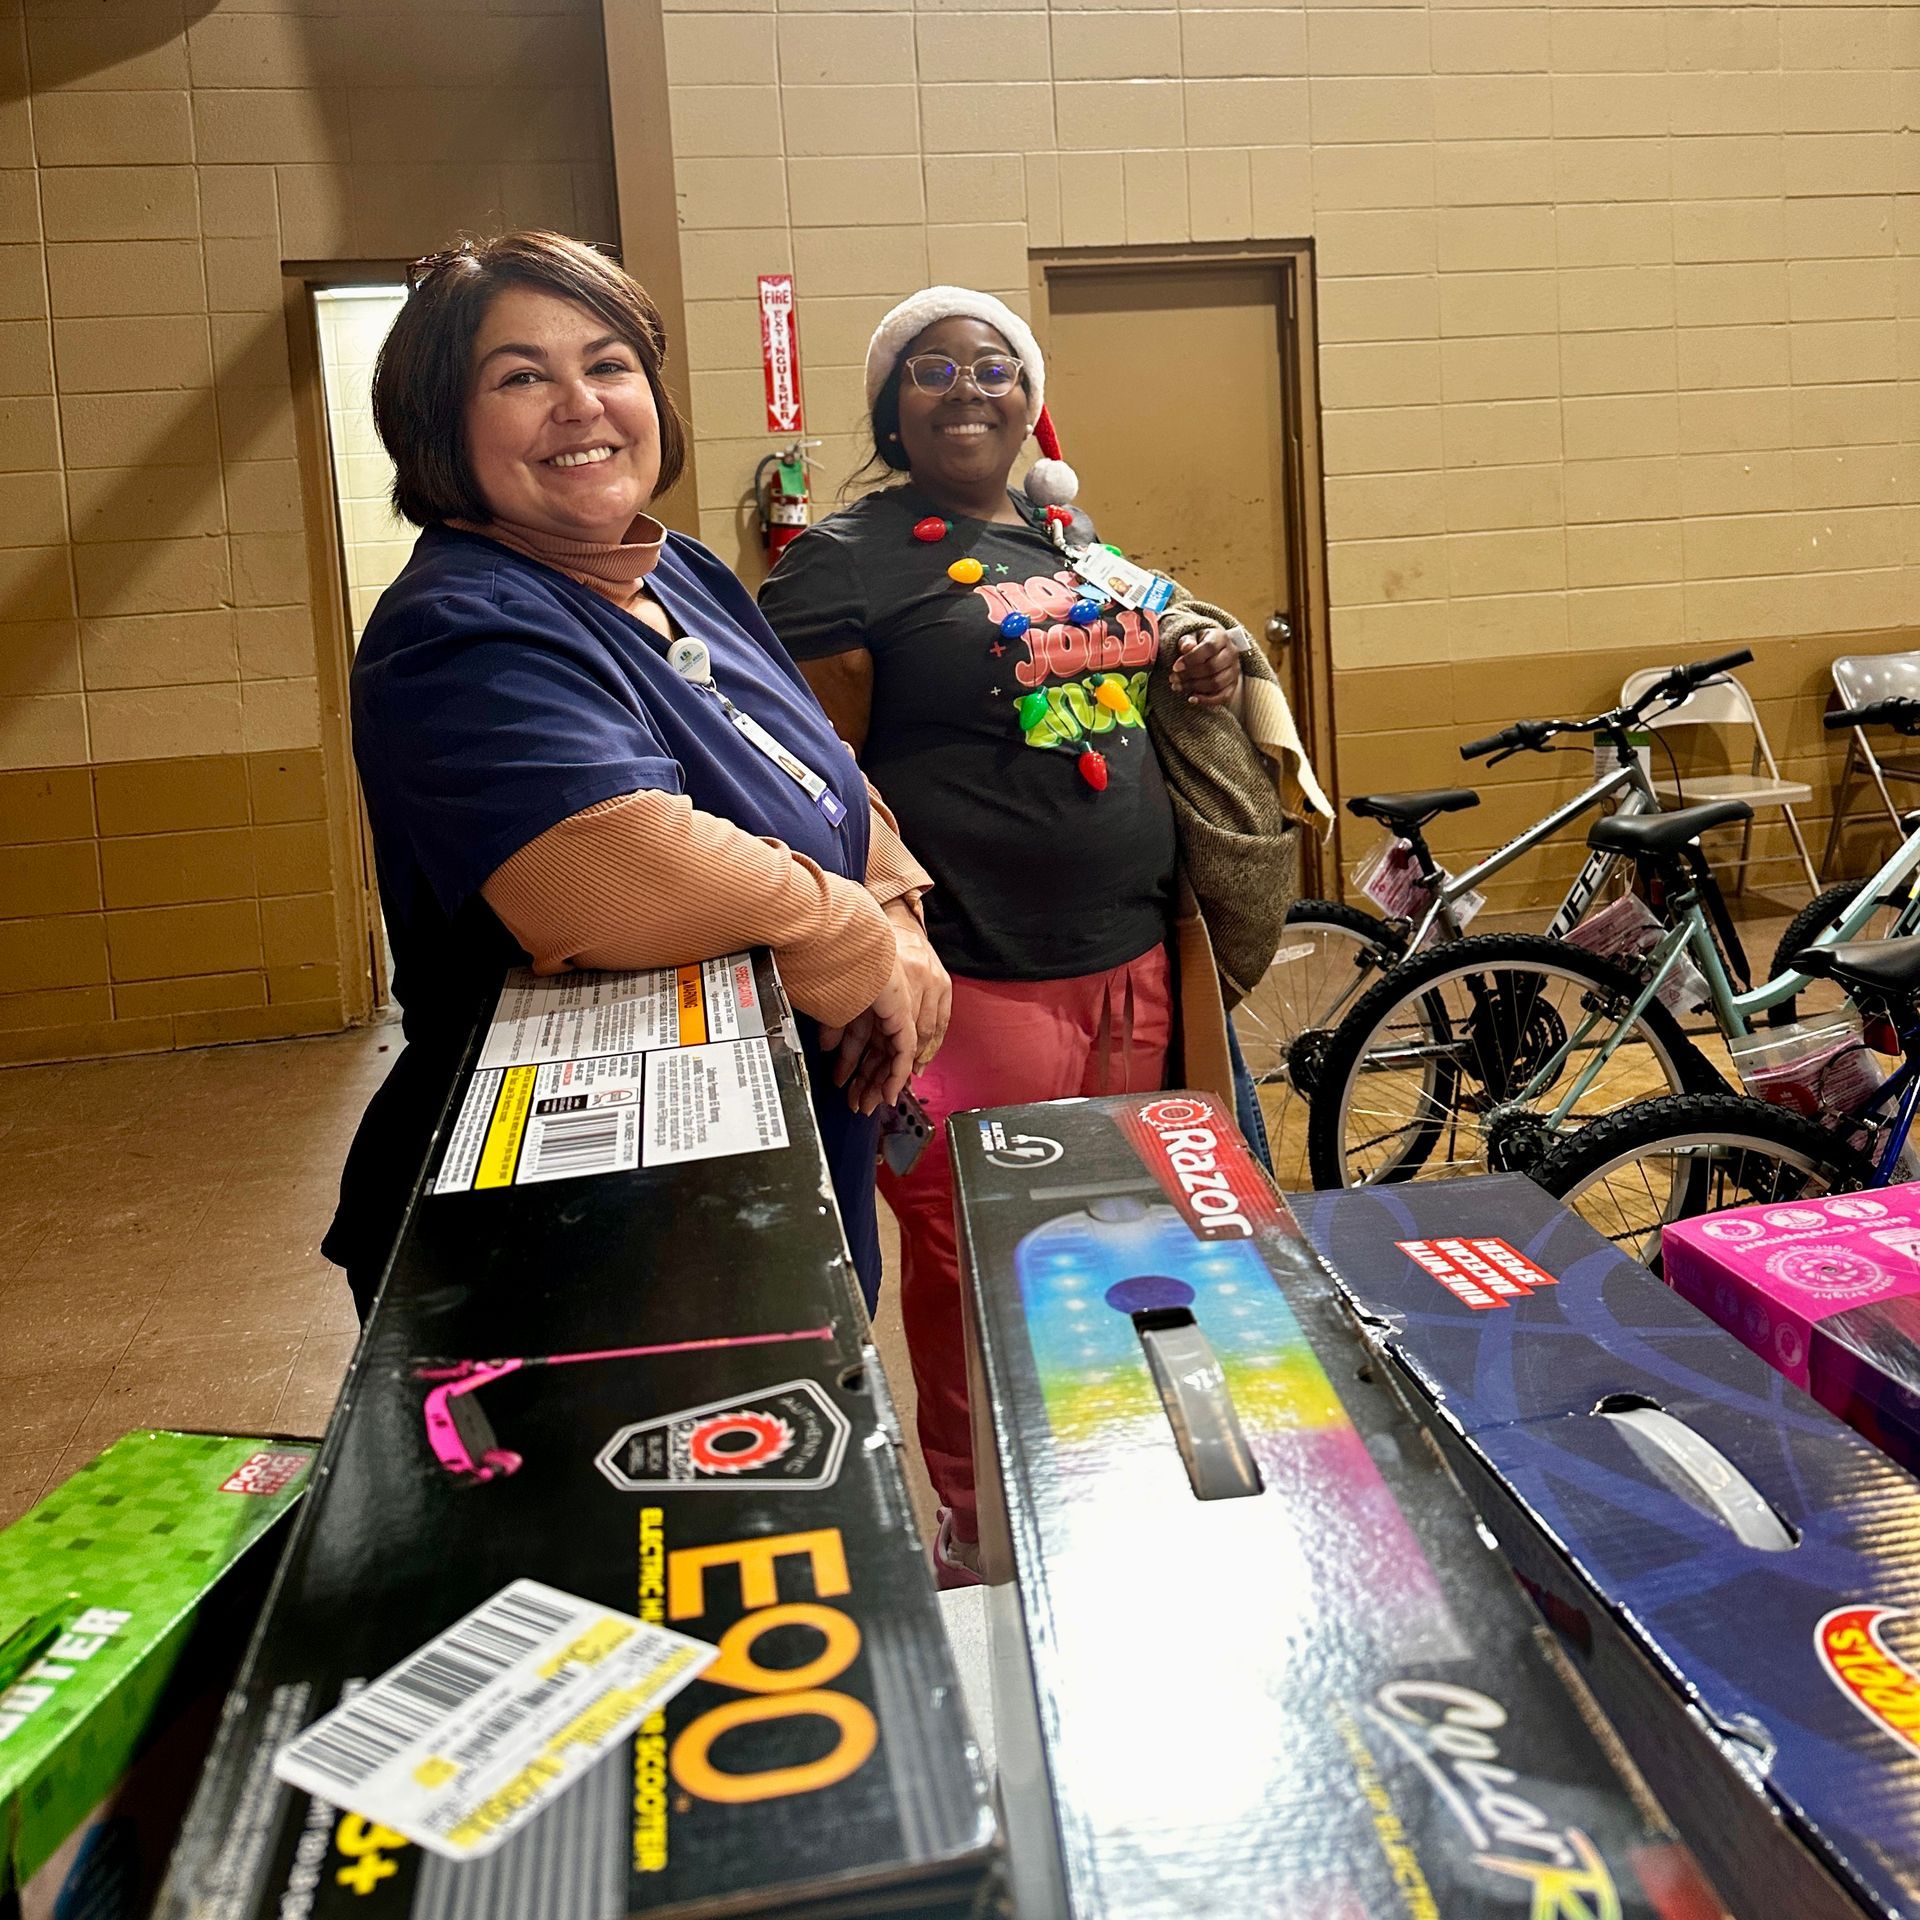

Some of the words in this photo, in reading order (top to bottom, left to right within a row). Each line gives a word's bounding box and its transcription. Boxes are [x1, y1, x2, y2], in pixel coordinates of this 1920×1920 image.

[764, 289, 790, 305] FIRE
[773, 309, 791, 420] EXTINGUISHER
[681, 984, 699, 1009] WARNING
[733, 964, 756, 1009] SPECIFICATIONS
[1399, 1241, 1456, 1274] WITH
[1731, 1223, 1856, 1254] development
[1436, 1240, 1522, 1295] RACECAR
[1471, 1240, 1547, 1283] SPEED!
[1438, 1273, 1496, 1305] RIDE
[779, 1396, 825, 1475] AUTHENTIC
[638, 1506, 665, 1596] ELECTRIC
[666, 1527, 880, 1804] E90
[632, 1736, 669, 1873] SCOOTER
